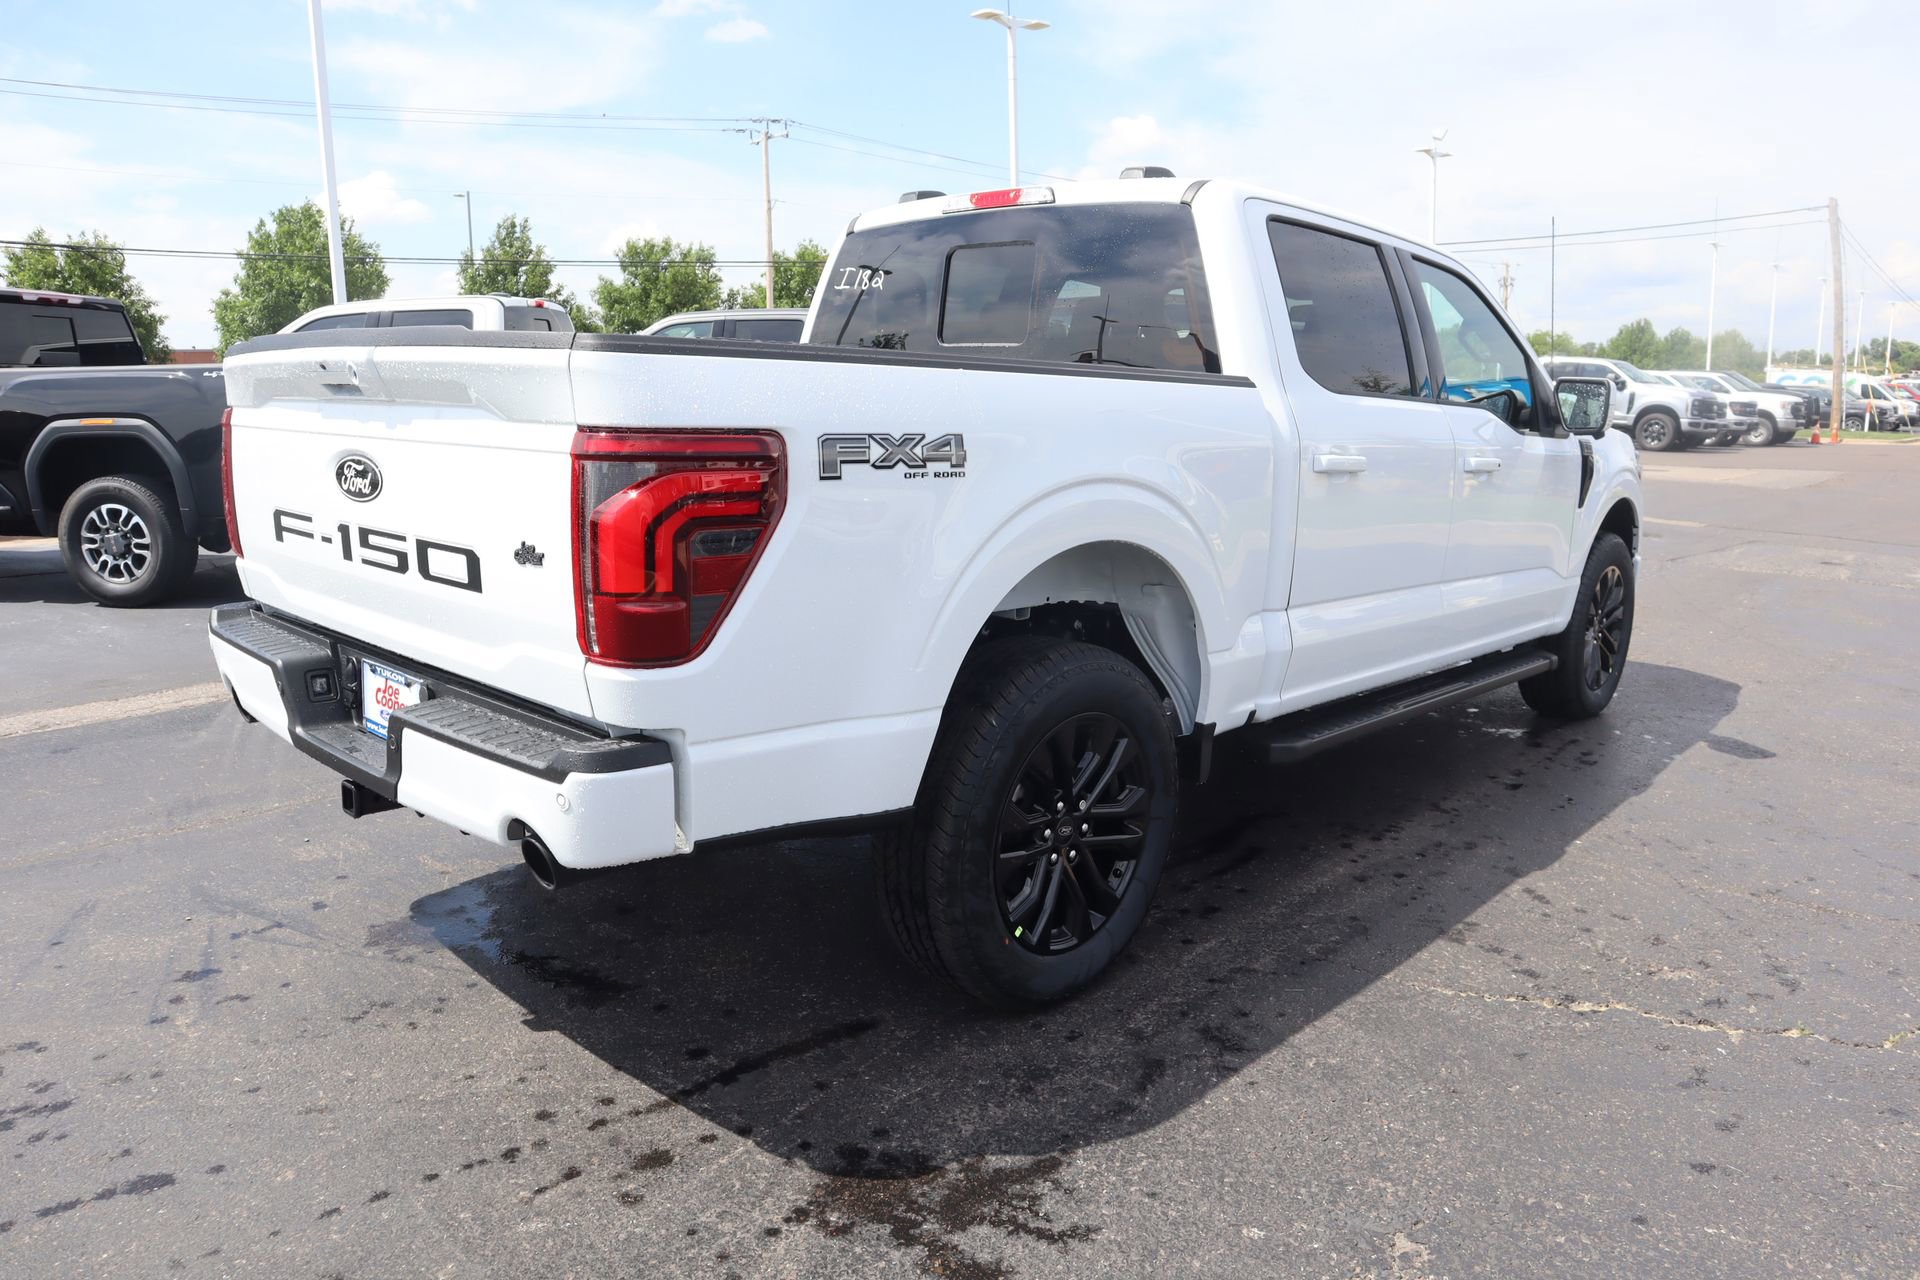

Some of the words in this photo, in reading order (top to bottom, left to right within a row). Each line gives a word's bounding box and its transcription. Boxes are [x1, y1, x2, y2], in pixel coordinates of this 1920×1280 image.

[834, 267, 885, 291] I182
[817, 433, 967, 481] FX4
[341, 461, 372, 495] Ford
[904, 472, 929, 480] OFF
[933, 471, 966, 479] ROAD
[273, 507, 483, 594] F-150
[376, 666, 405, 684] YUKON
[376, 688, 408, 710] Coop
[382, 678, 400, 700] Joe
